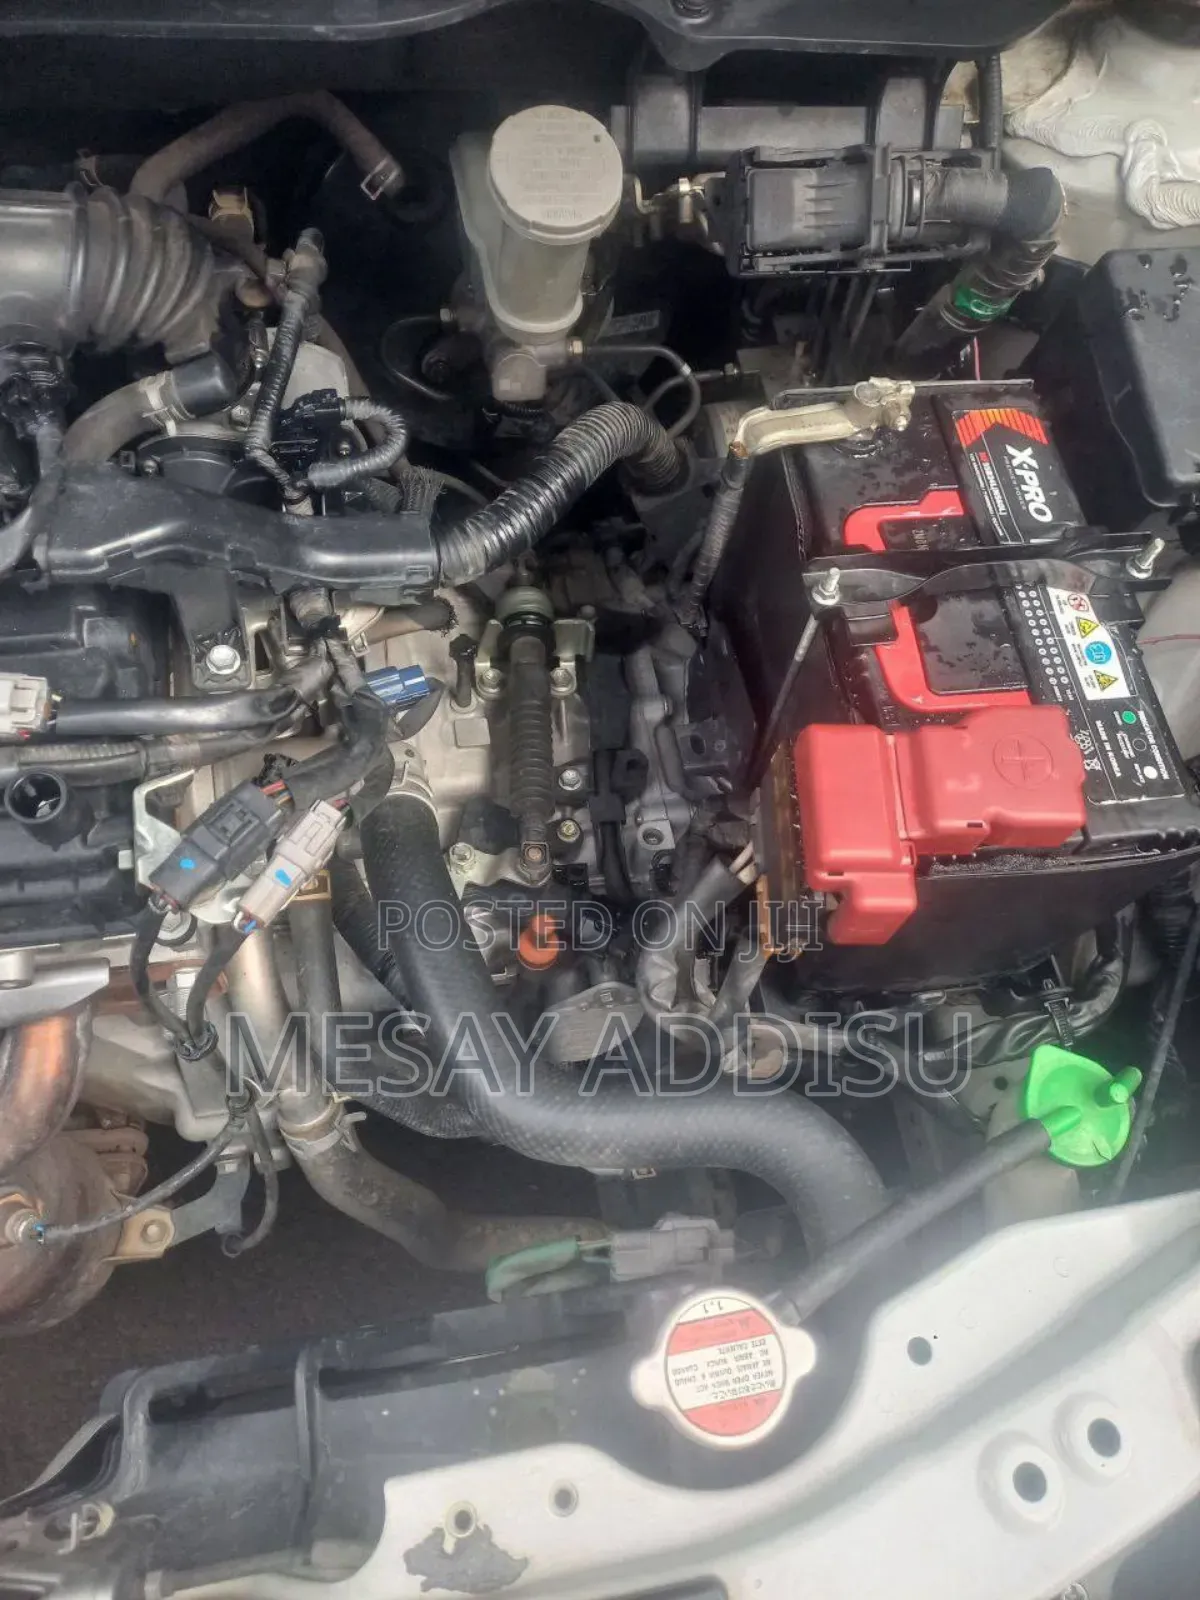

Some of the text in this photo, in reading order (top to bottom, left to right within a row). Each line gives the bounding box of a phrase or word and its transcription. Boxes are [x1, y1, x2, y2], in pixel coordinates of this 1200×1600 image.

[1004, 444, 1053, 523] X-PRO
[1095, 720, 1122, 777] MADE IN KOREA
[1138, 710, 1170, 780] INDICATOR CONDITION
